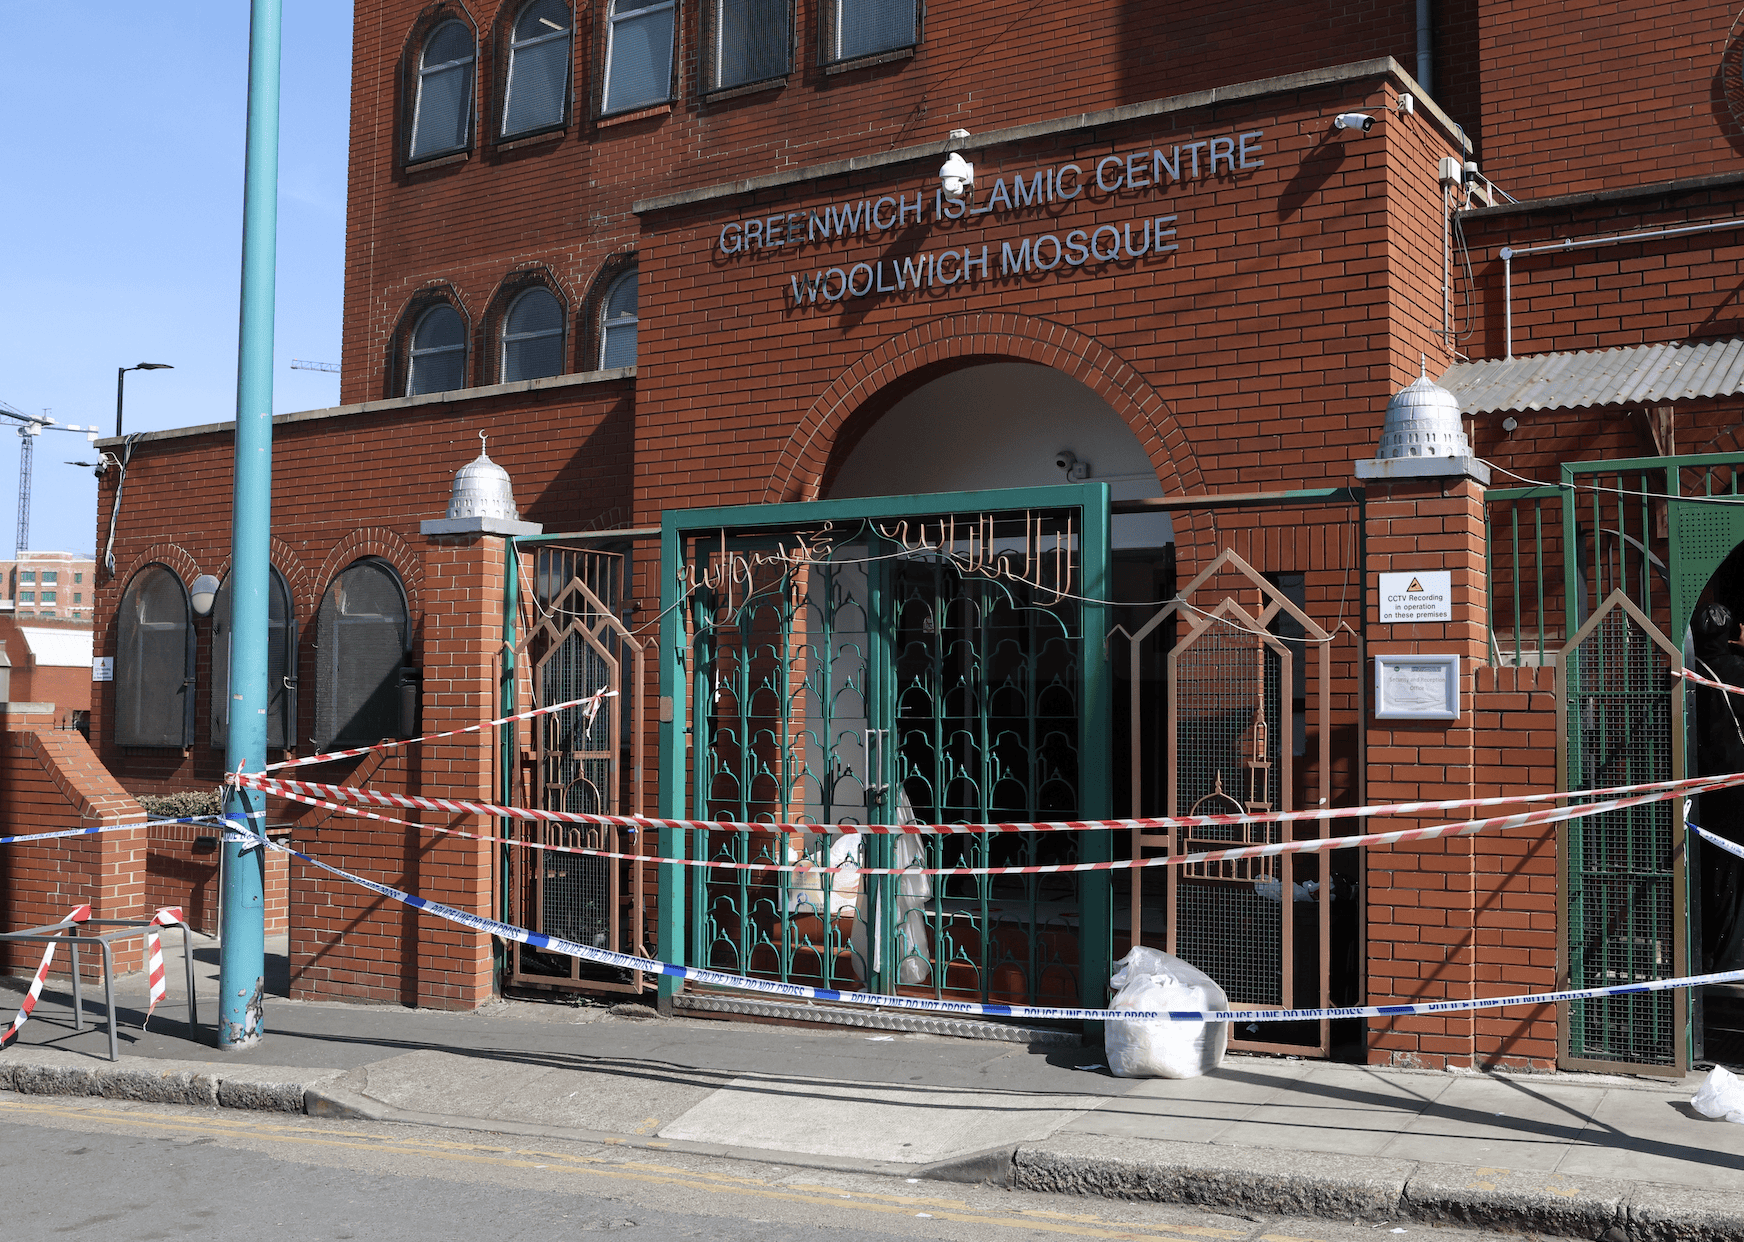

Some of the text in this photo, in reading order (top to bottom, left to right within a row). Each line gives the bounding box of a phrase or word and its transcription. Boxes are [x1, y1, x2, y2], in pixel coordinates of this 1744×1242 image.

[718, 131, 1265, 254] GREENWICH ISLAMIC CENTRE
[790, 215, 1179, 305] WOOLWICH MOSQUE
[1387, 594, 1443, 602] CCTV Recording
[1403, 603, 1436, 611] operation
[1416, 611, 1448, 619] premises
[429, 904, 522, 939] POLICE LINE DO NOT CROSS
[554, 940, 656, 971] POLICE LINE DO NOT CROSS
[694, 970, 805, 996] POLICE LINE DO NOT CROSS
[850, 993, 882, 1004] POLICE
[920, 1000, 940, 1010] NOT
